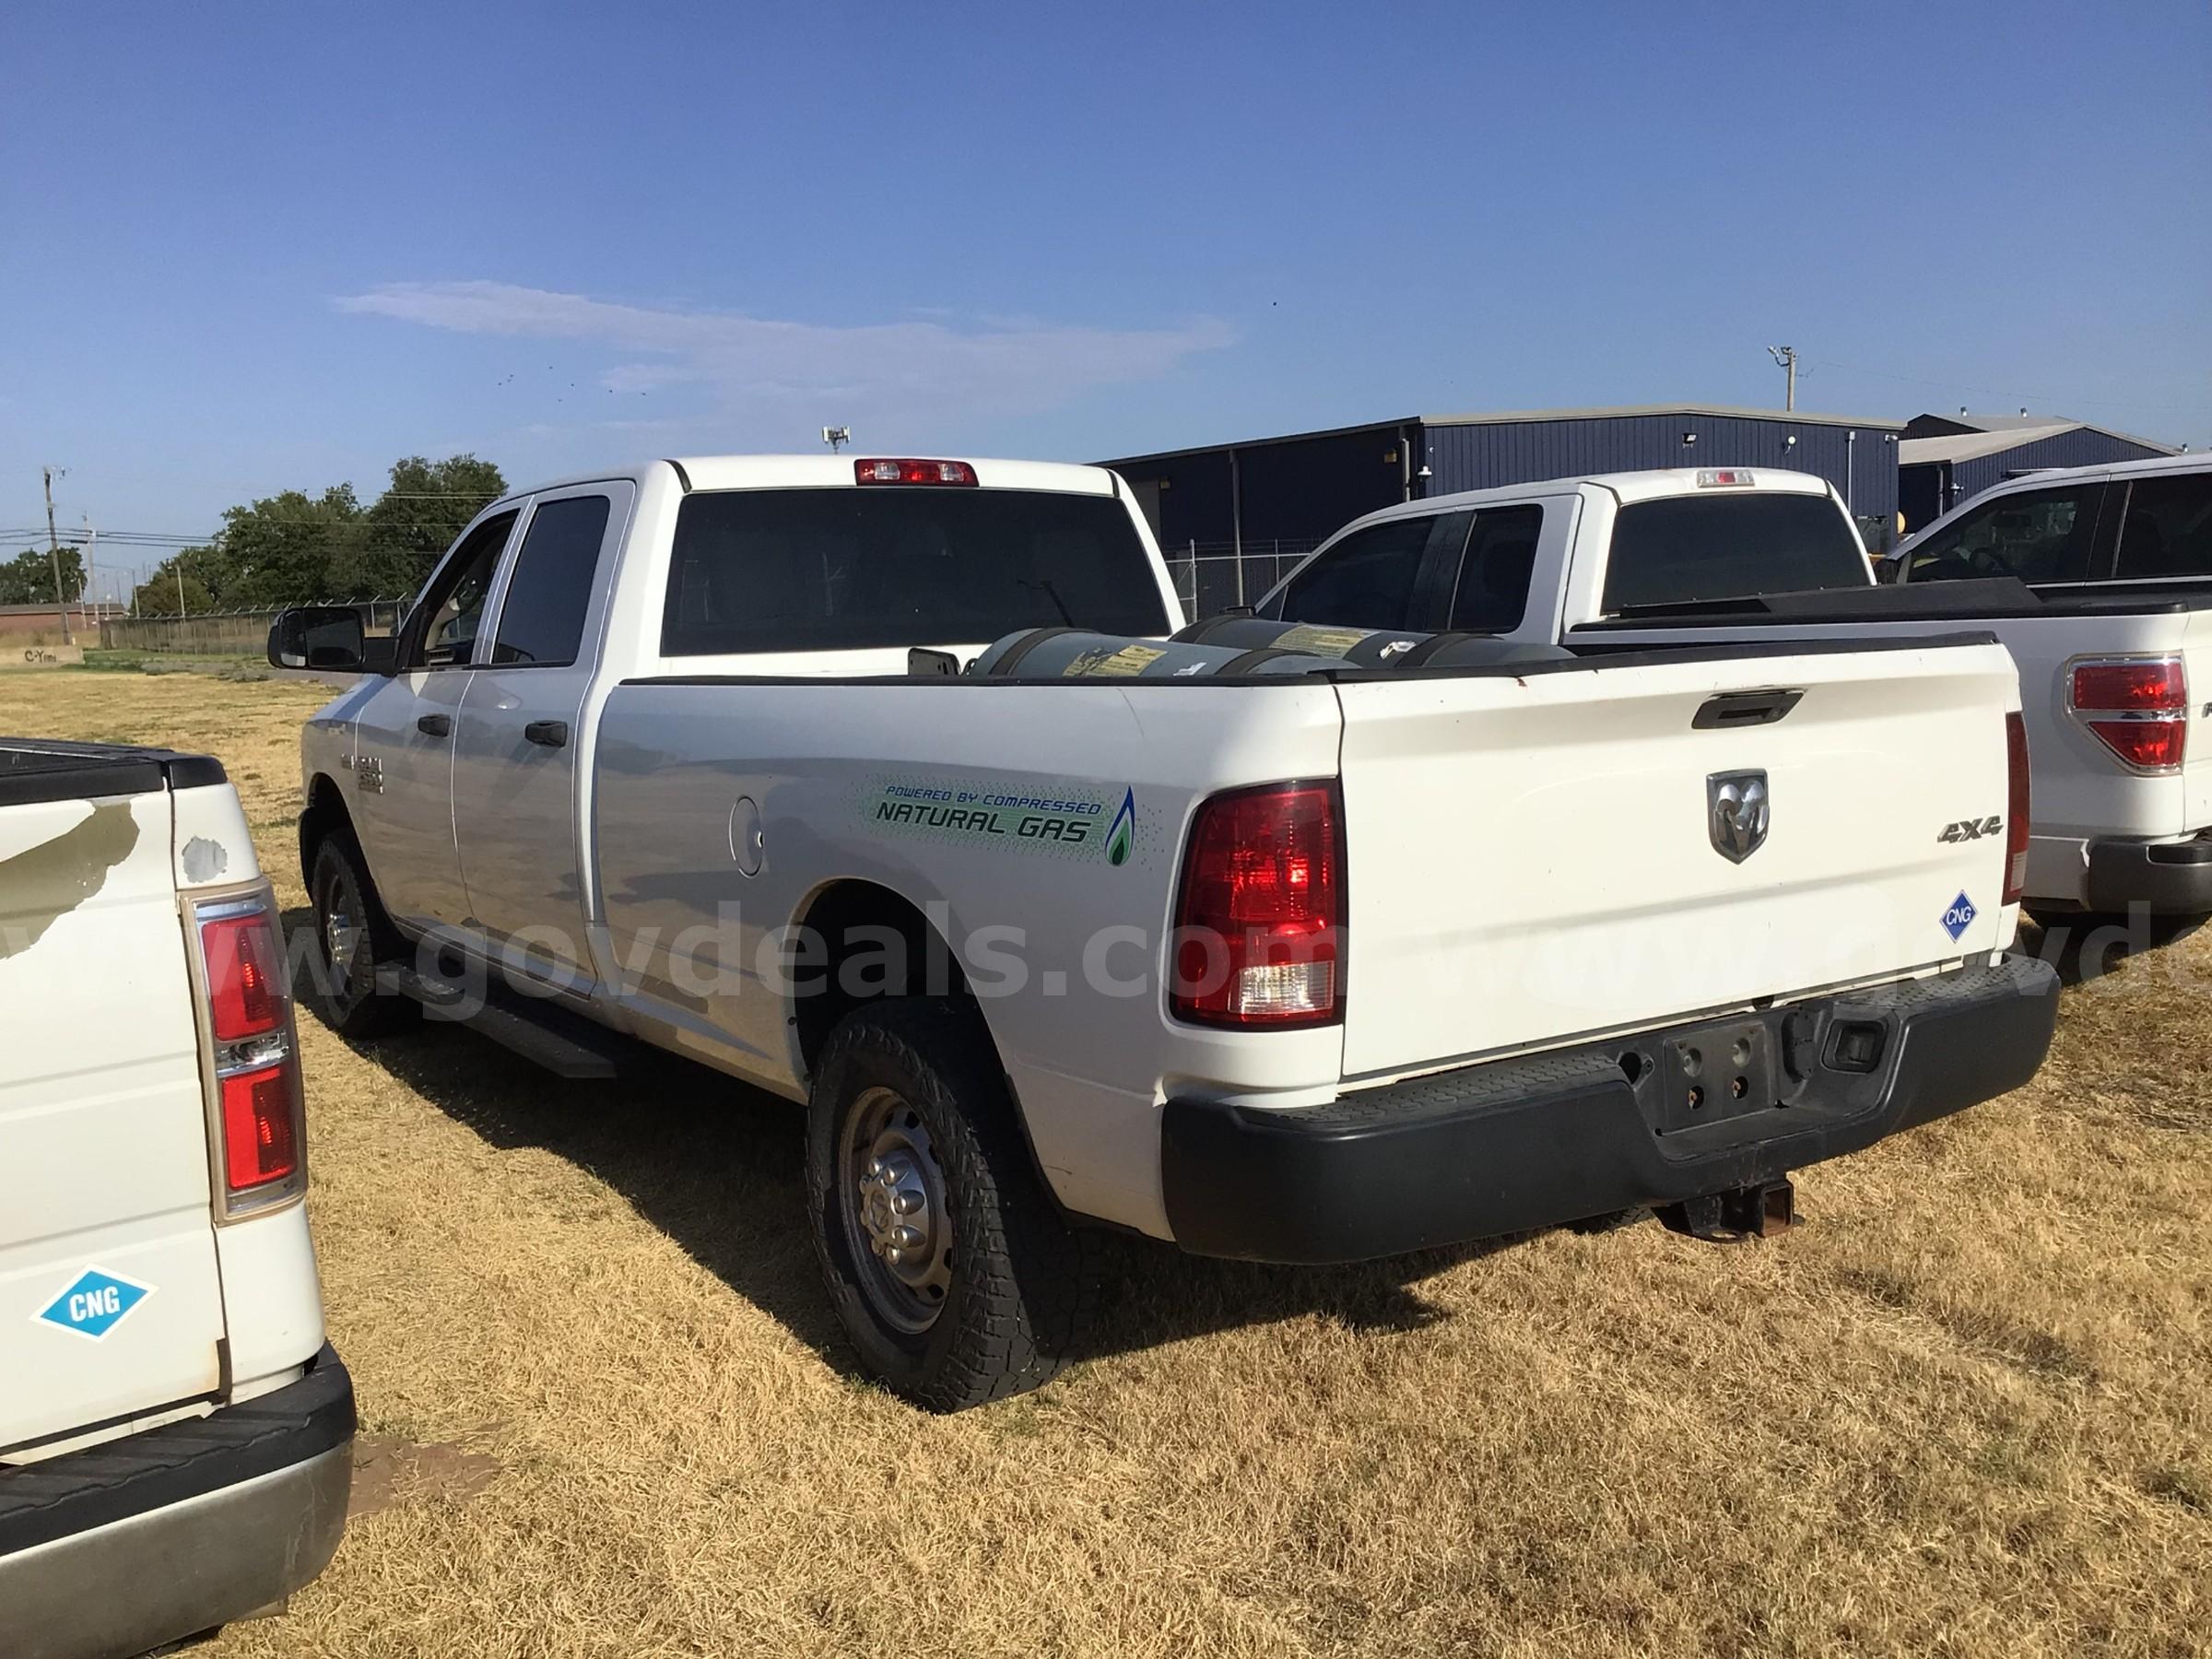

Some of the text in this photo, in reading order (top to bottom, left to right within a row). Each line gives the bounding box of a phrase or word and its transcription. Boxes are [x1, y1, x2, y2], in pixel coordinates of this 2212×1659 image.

[886, 785, 1101, 815] POWERED BY COMPRESSED
[877, 802, 1091, 842] NATURAL GAS
[1946, 906, 1972, 926] CNG
[69, 1286, 121, 1323] CNG
